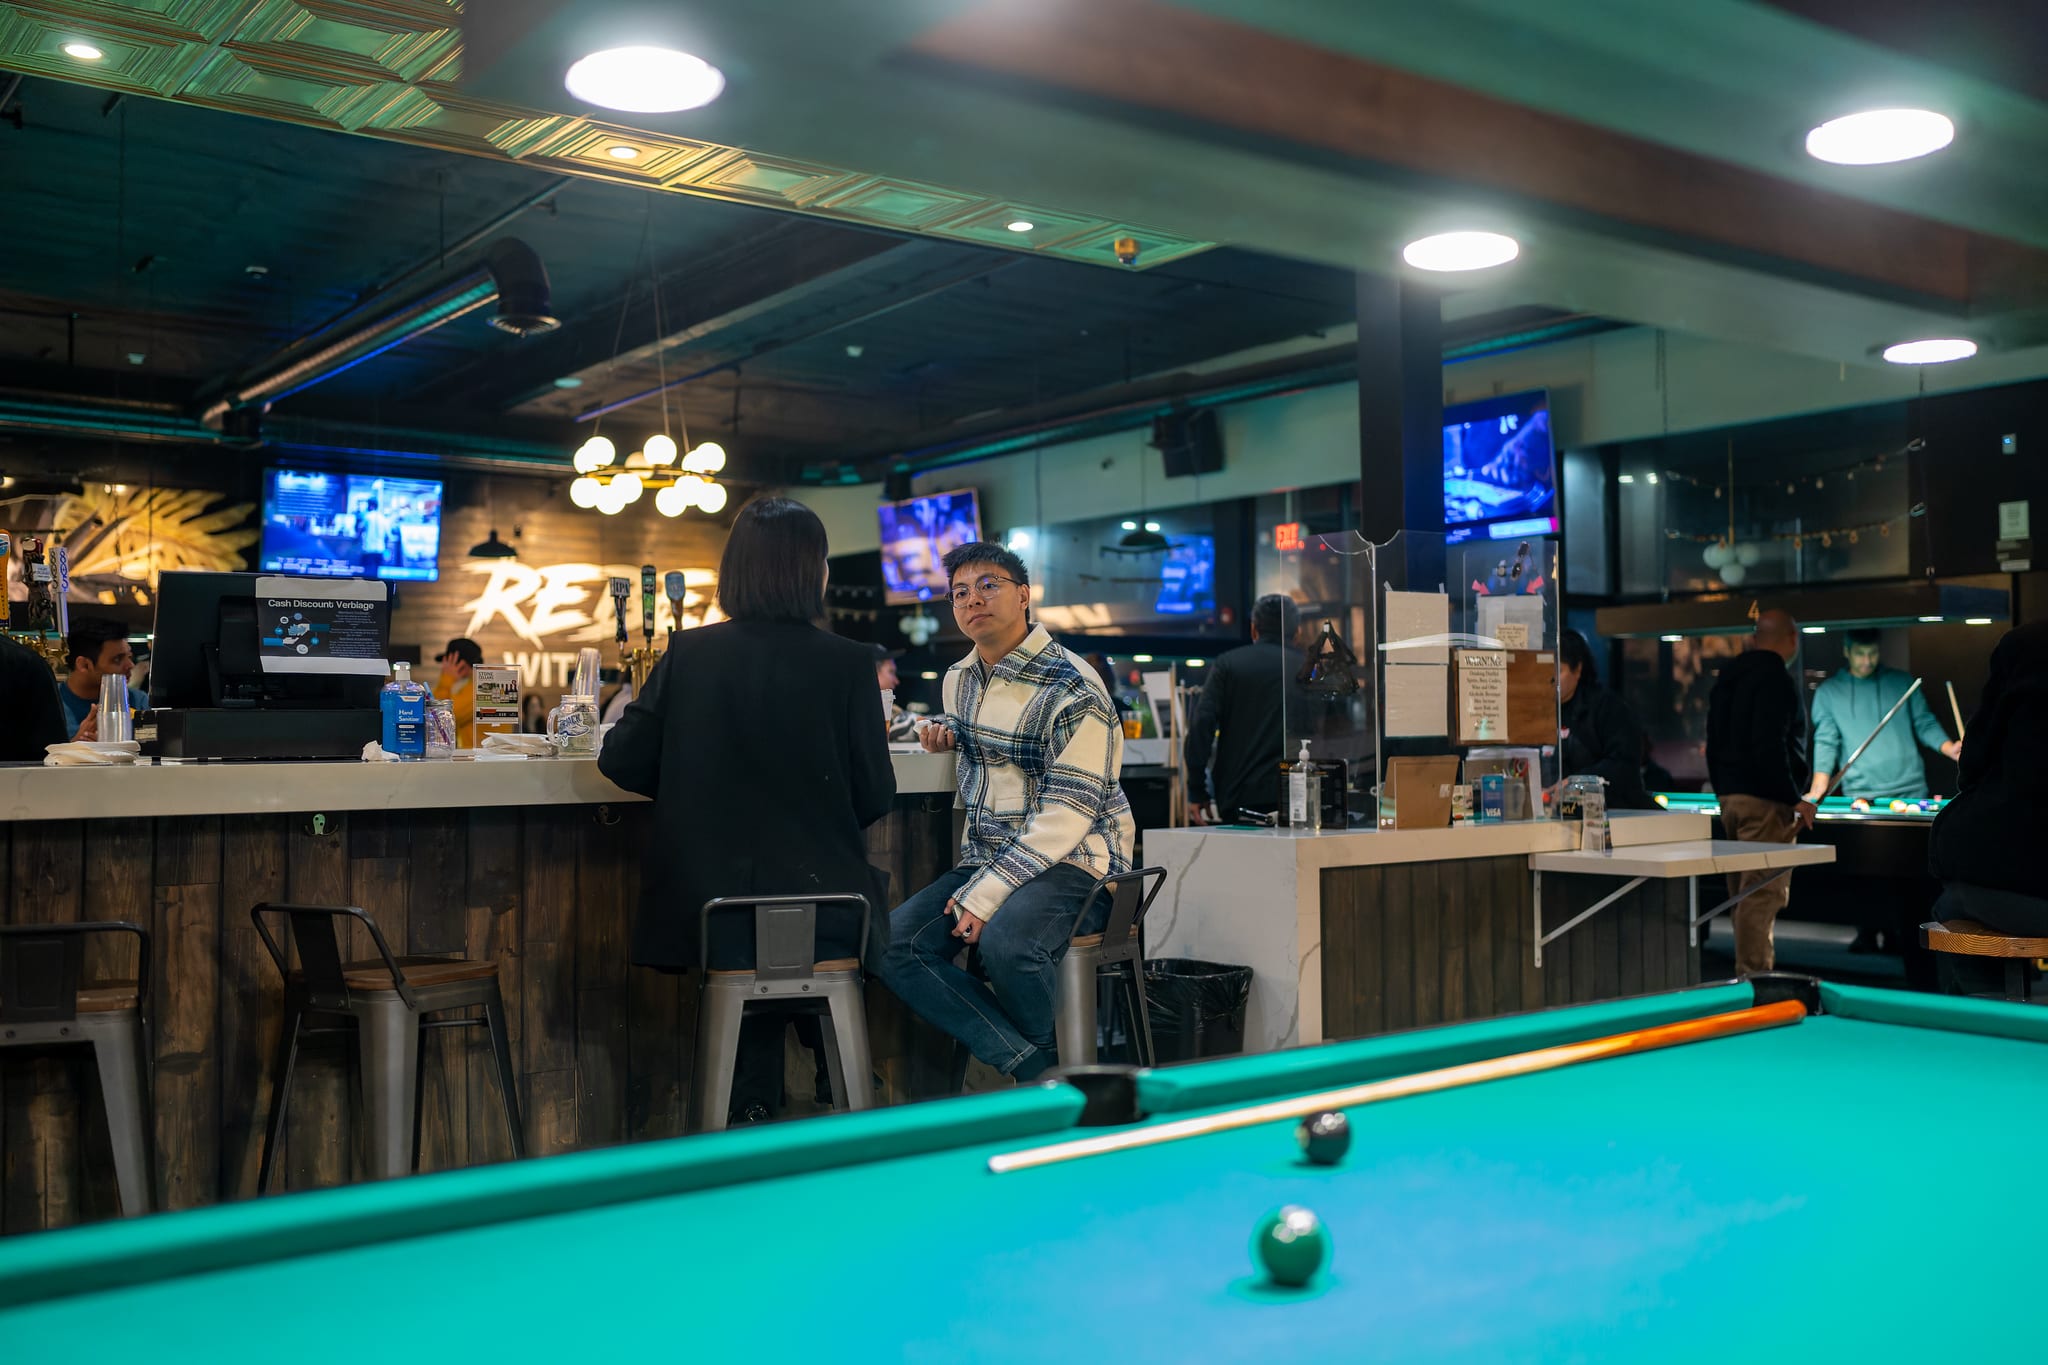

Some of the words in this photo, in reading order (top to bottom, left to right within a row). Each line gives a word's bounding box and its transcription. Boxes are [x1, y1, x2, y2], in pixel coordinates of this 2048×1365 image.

[615, 581, 629, 593] IPA
[268, 599, 292, 608] Cash
[293, 599, 334, 609] Discount
[335, 600, 375, 611] Verbiage
[1746, 599, 1761, 622] 4
[502, 651, 576, 688] WIT
[398, 708, 414, 716] Hand
[1485, 807, 1502, 817] VISA
